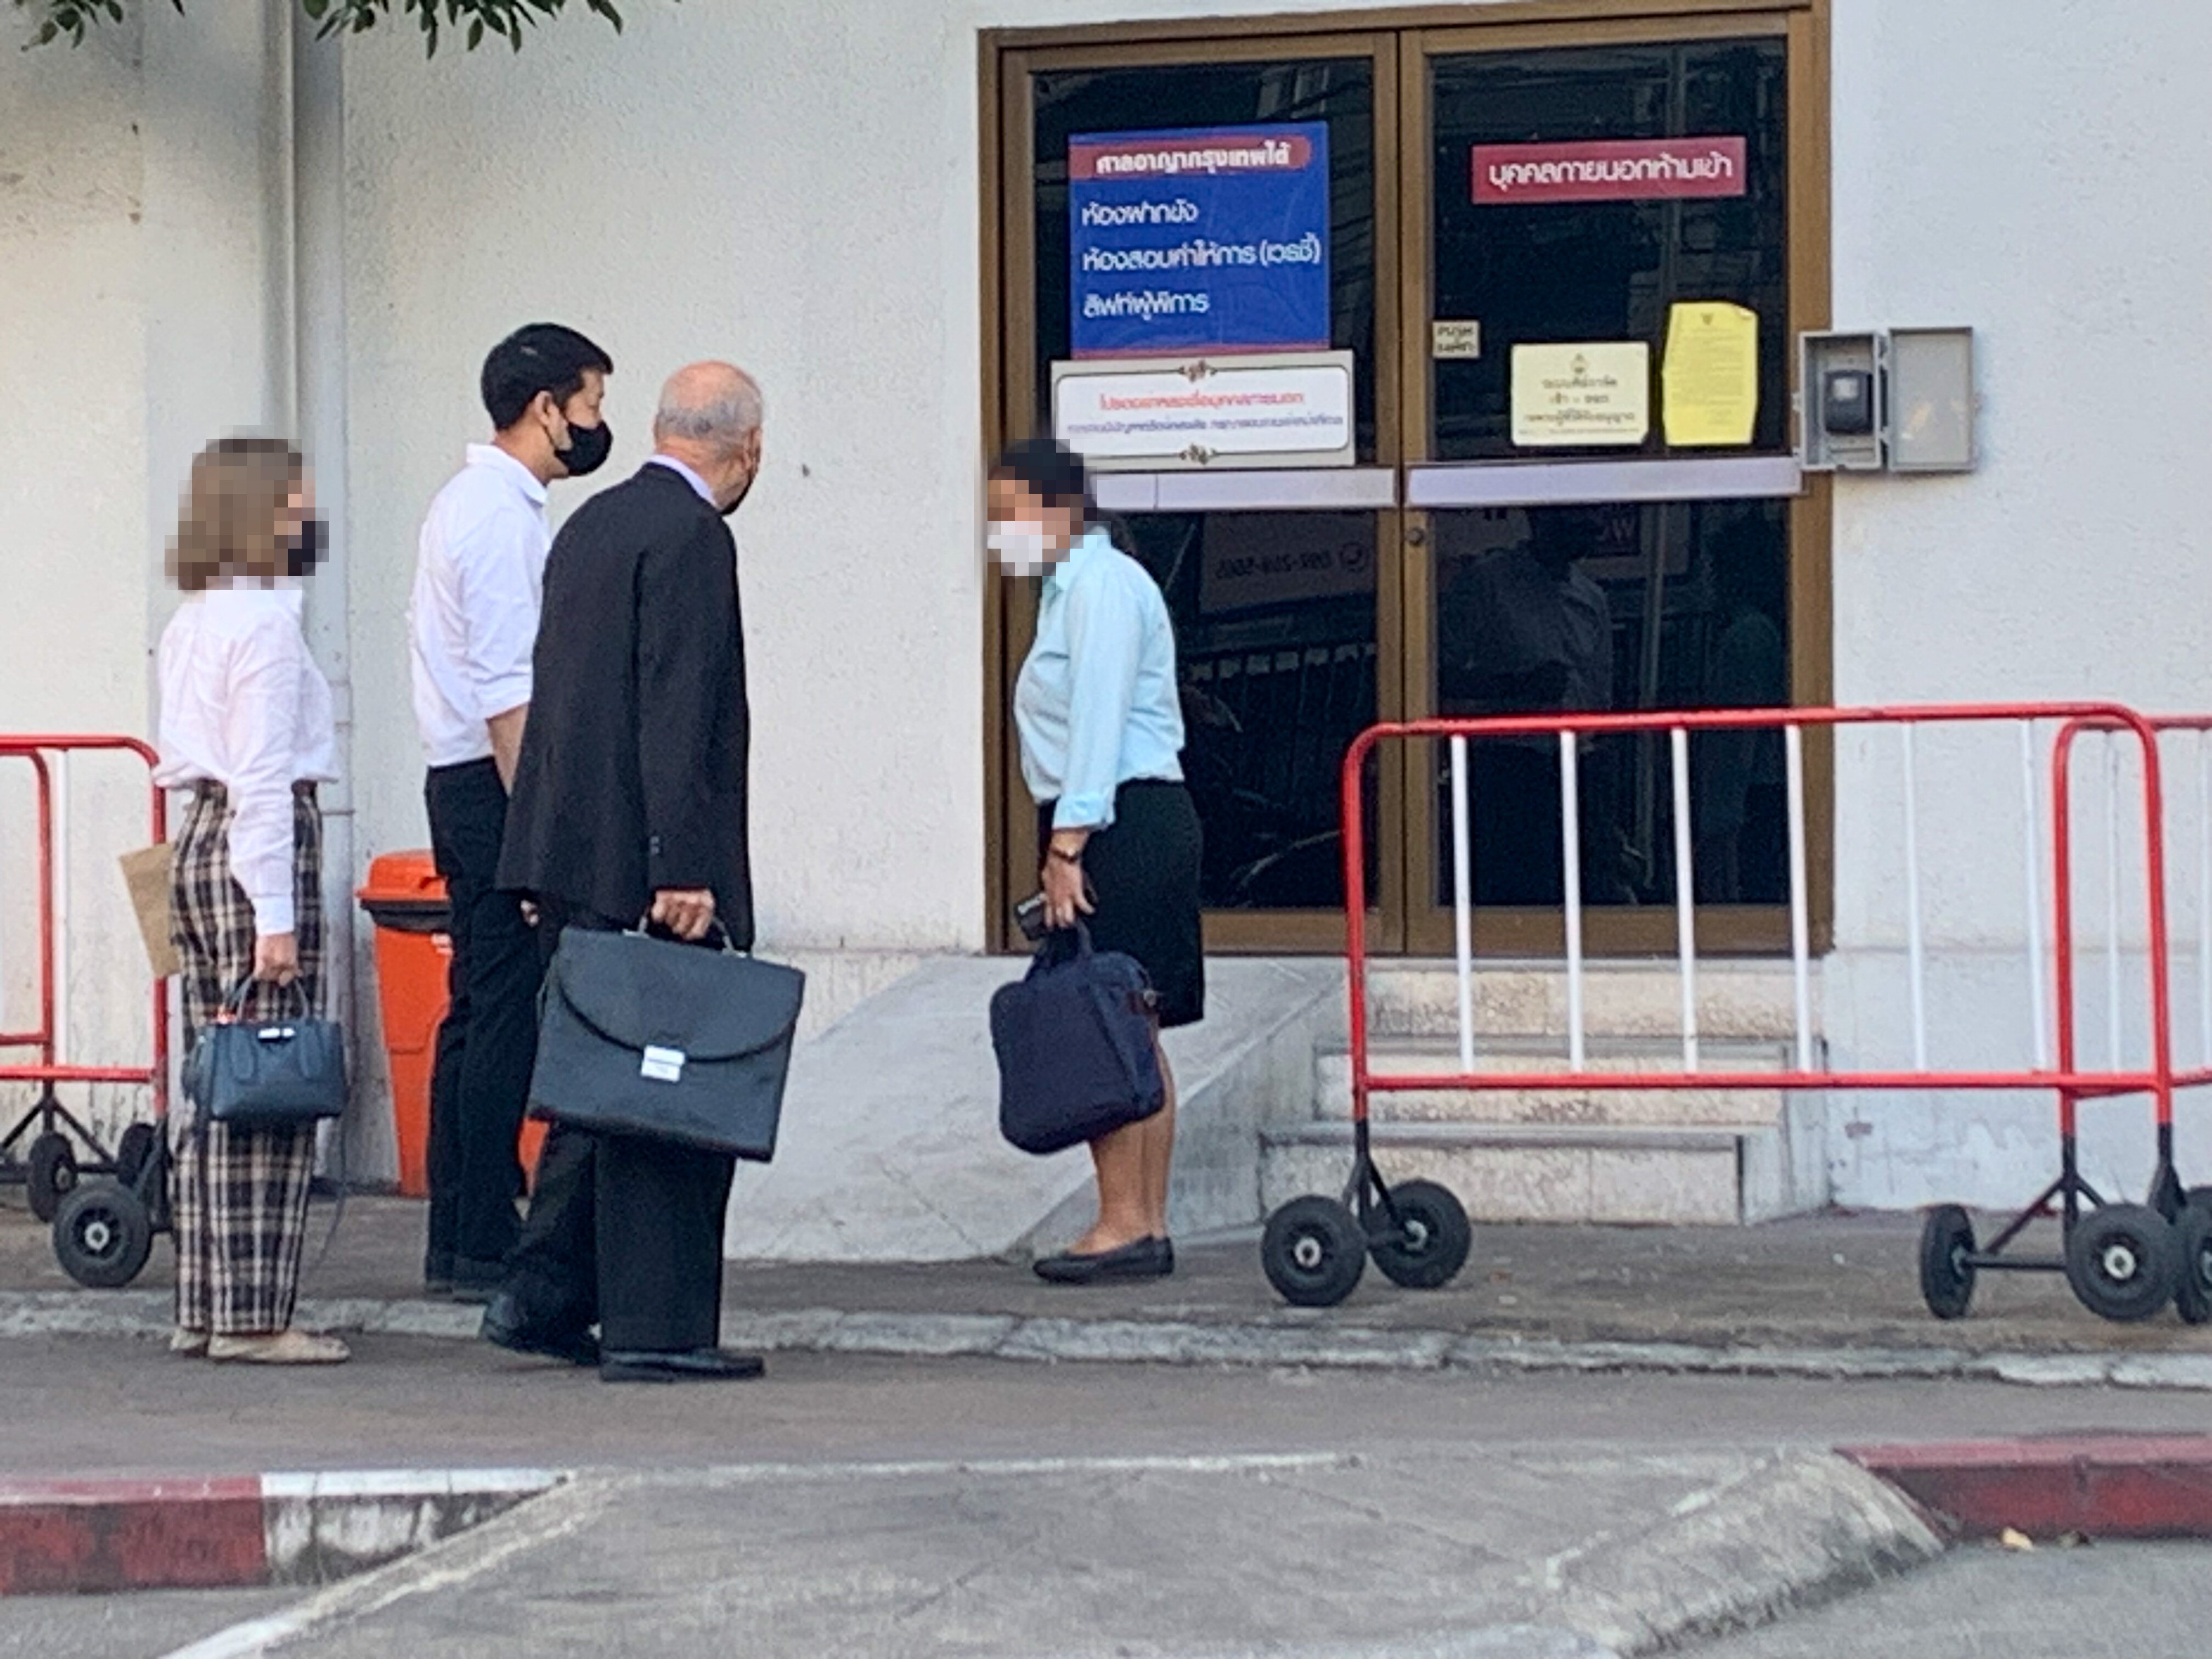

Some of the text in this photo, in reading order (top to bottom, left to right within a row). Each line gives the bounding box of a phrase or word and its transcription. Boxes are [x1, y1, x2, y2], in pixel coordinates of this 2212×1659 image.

[1096, 140, 1290, 174] ศาลอาญากรุงเทพใต้
[1489, 151, 1733, 191] บุคคลภายนอกห้ามเข้า
[1082, 199, 1199, 225] ห้องฝากขัง
[1082, 239, 1257, 271] ห้องสอบคำให้การ
